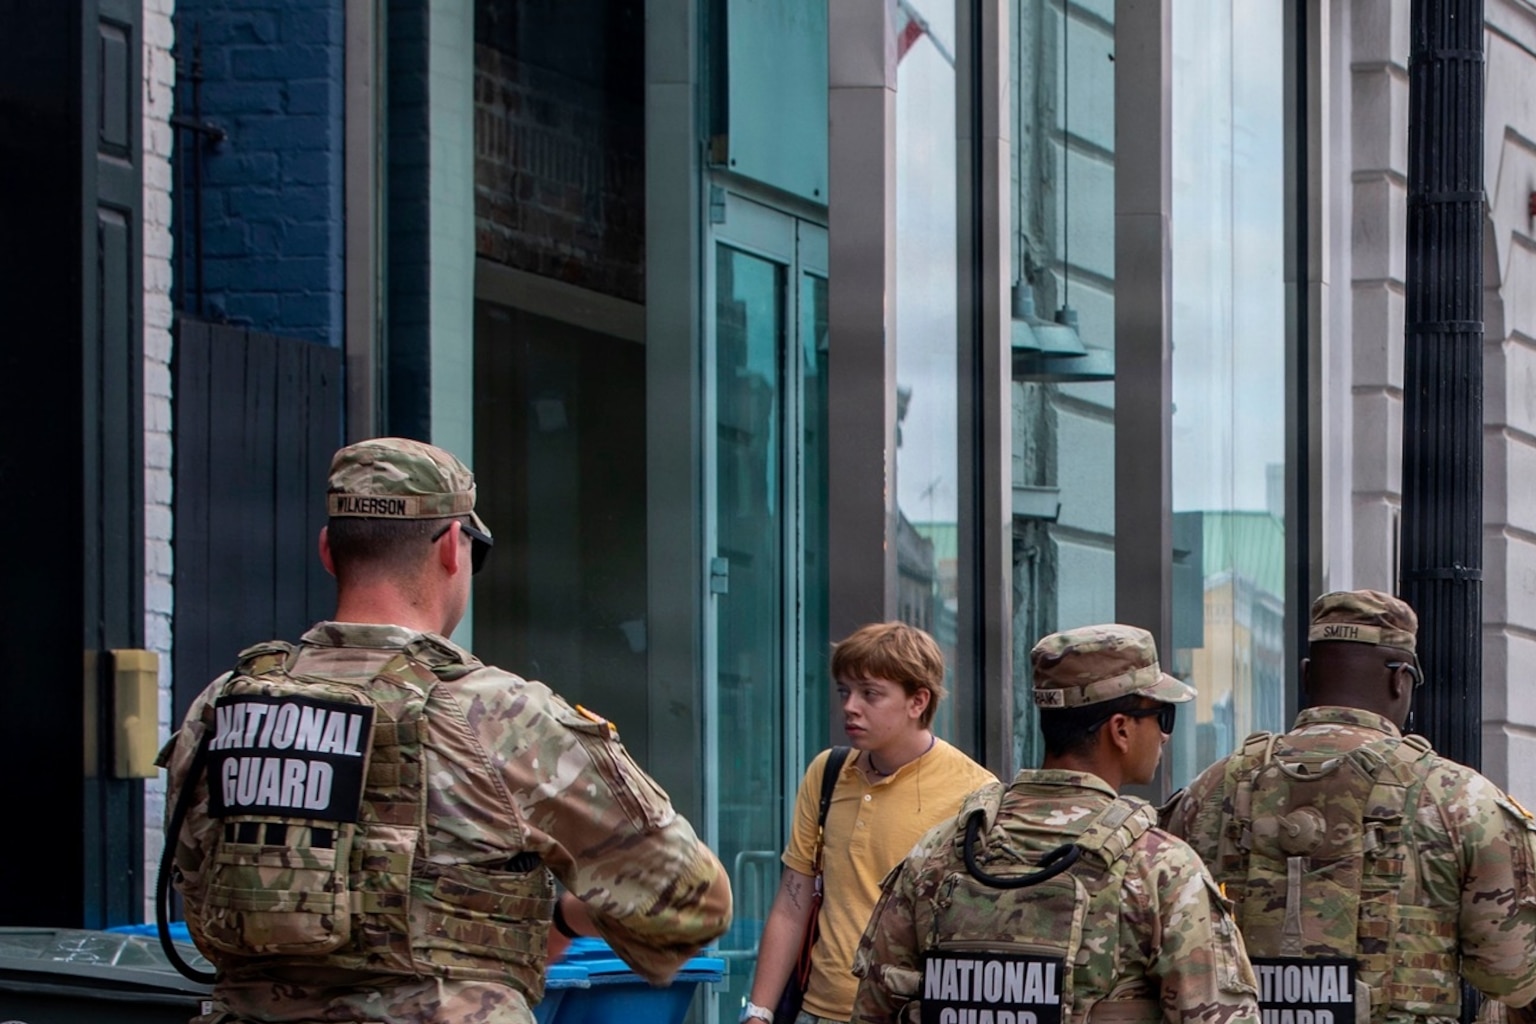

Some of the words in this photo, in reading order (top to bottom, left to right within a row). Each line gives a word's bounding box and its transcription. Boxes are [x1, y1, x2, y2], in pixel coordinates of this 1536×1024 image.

[337, 496, 406, 516] WILKERSON
[1323, 625, 1359, 639] SMITH
[208, 702, 363, 757] NATIONAL
[222, 756, 334, 811] GUARD
[924, 957, 1060, 1005] NATIONAL
[1252, 964, 1353, 1004] TIONAL
